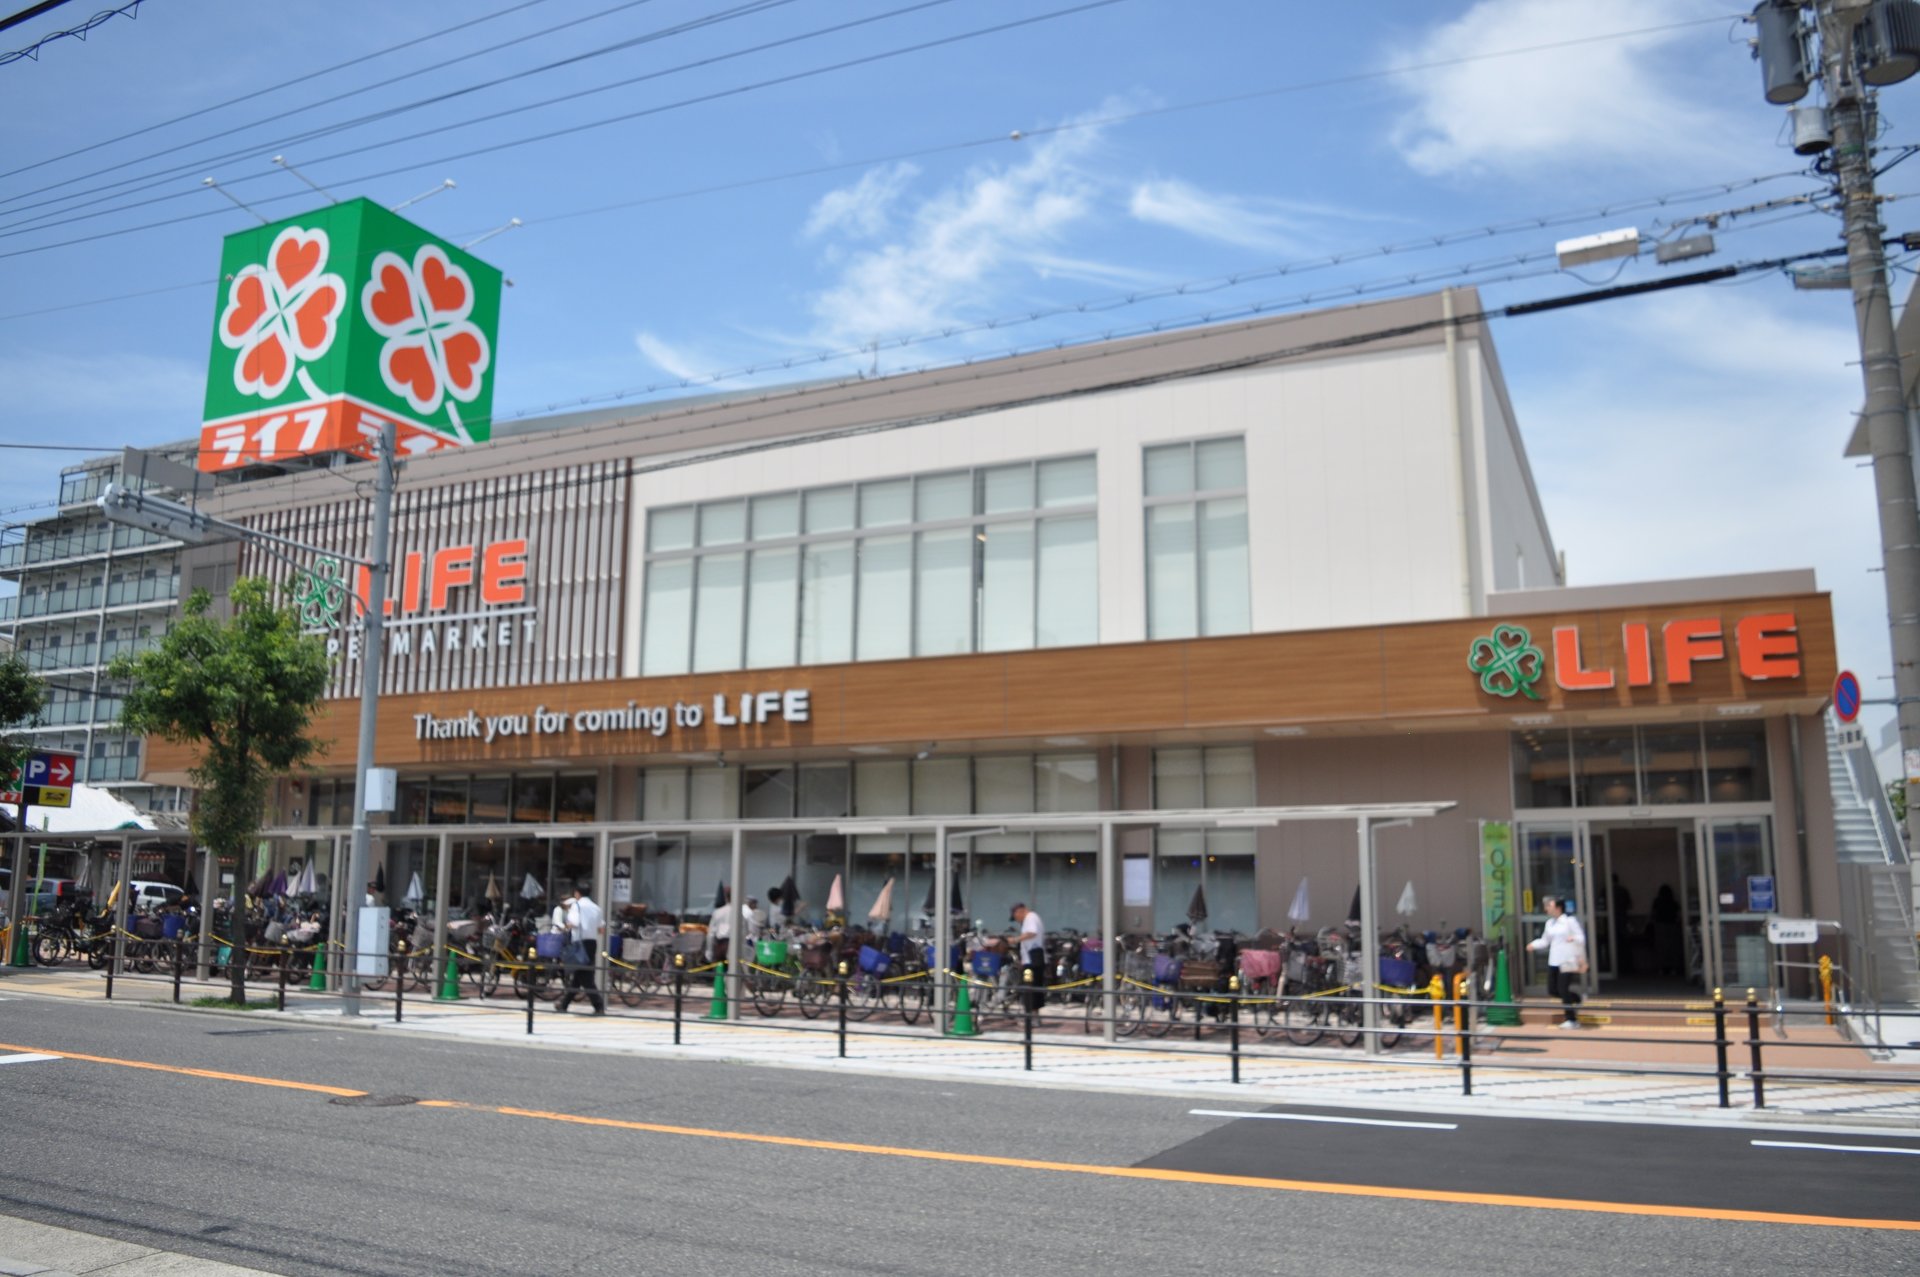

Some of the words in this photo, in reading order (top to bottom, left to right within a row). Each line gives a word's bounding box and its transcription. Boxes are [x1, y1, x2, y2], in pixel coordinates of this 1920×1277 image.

[212, 408, 328, 465] ライフ
[356, 538, 528, 617] LIFE
[1551, 612, 1801, 691] LIFE
[413, 709, 481, 741] Thank
[484, 715, 529, 743] you
[533, 704, 569, 734] for
[573, 700, 669, 737] coming
[675, 701, 703, 728] to
[713, 688, 811, 726] LIFE
[29, 760, 46, 779] P
